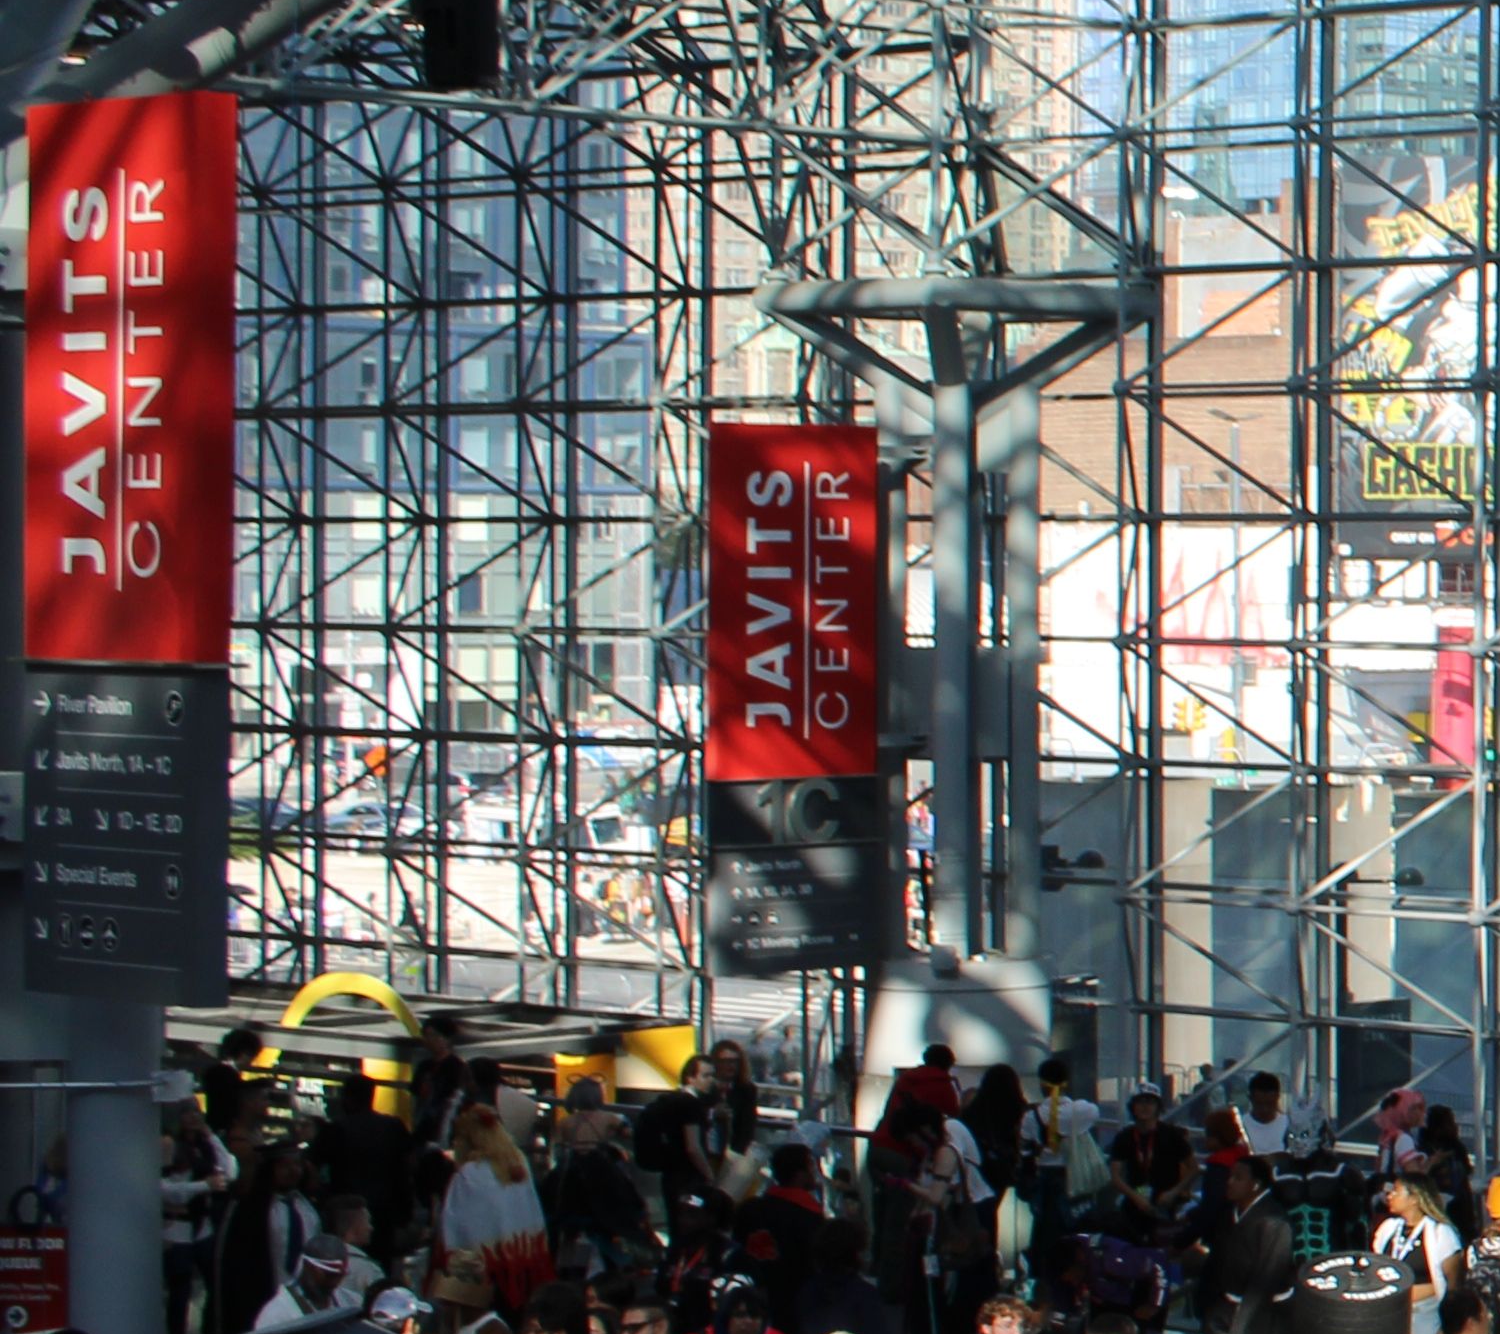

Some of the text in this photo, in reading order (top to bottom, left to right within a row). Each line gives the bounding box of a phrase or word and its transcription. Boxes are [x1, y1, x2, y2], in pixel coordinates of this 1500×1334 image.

[60, 184, 110, 577] JAVITS
[124, 177, 167, 580] CENTER
[745, 469, 794, 729] JAVITS
[814, 470, 851, 730] CENTER
[55, 750, 90, 772] Javits
[90, 752, 127, 775] North,
[86, 694, 133, 717] Pavilion
[56, 864, 137, 889] Special Events
[756, 778, 840, 845] 1C
